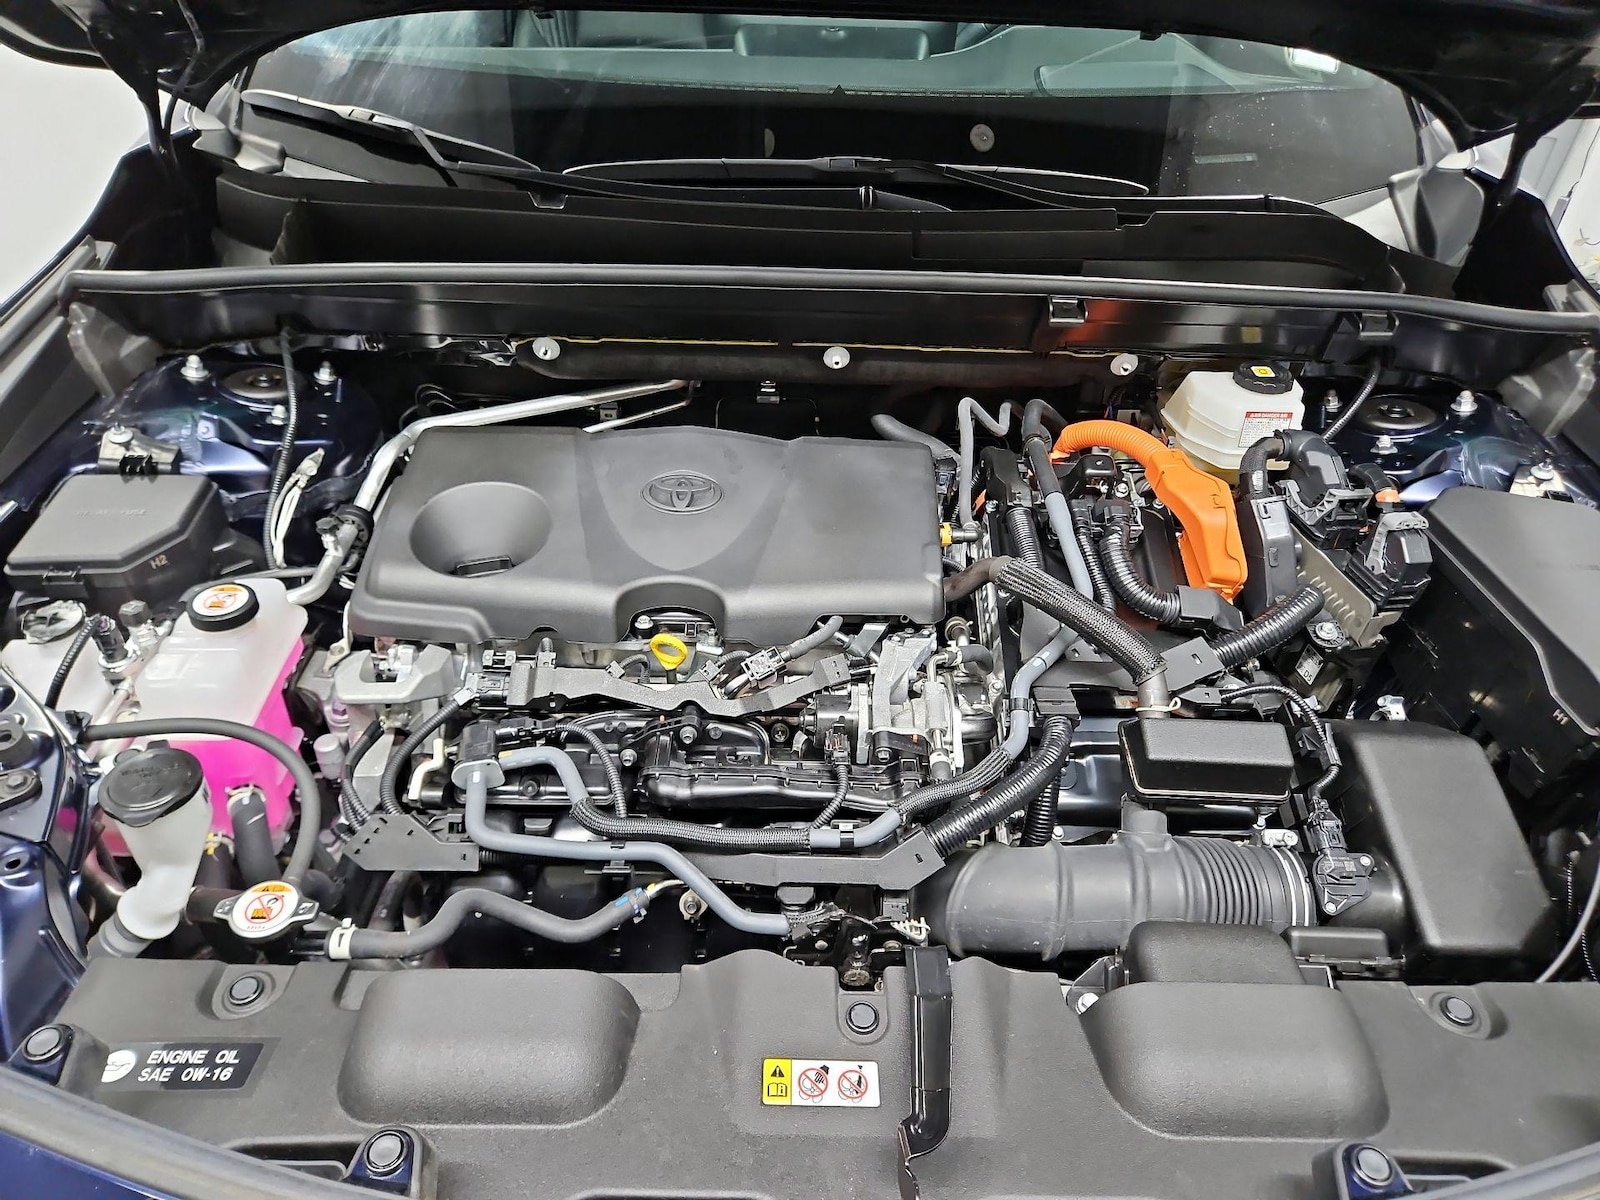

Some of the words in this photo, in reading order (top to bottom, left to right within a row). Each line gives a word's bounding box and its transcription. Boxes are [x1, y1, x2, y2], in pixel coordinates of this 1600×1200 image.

[149, 554, 168, 570] H2
[147, 1050, 208, 1064] ENGINE
[215, 1050, 239, 1064] OIL
[137, 1067, 176, 1082] SAE
[181, 1067, 233, 1081] 0W-16
